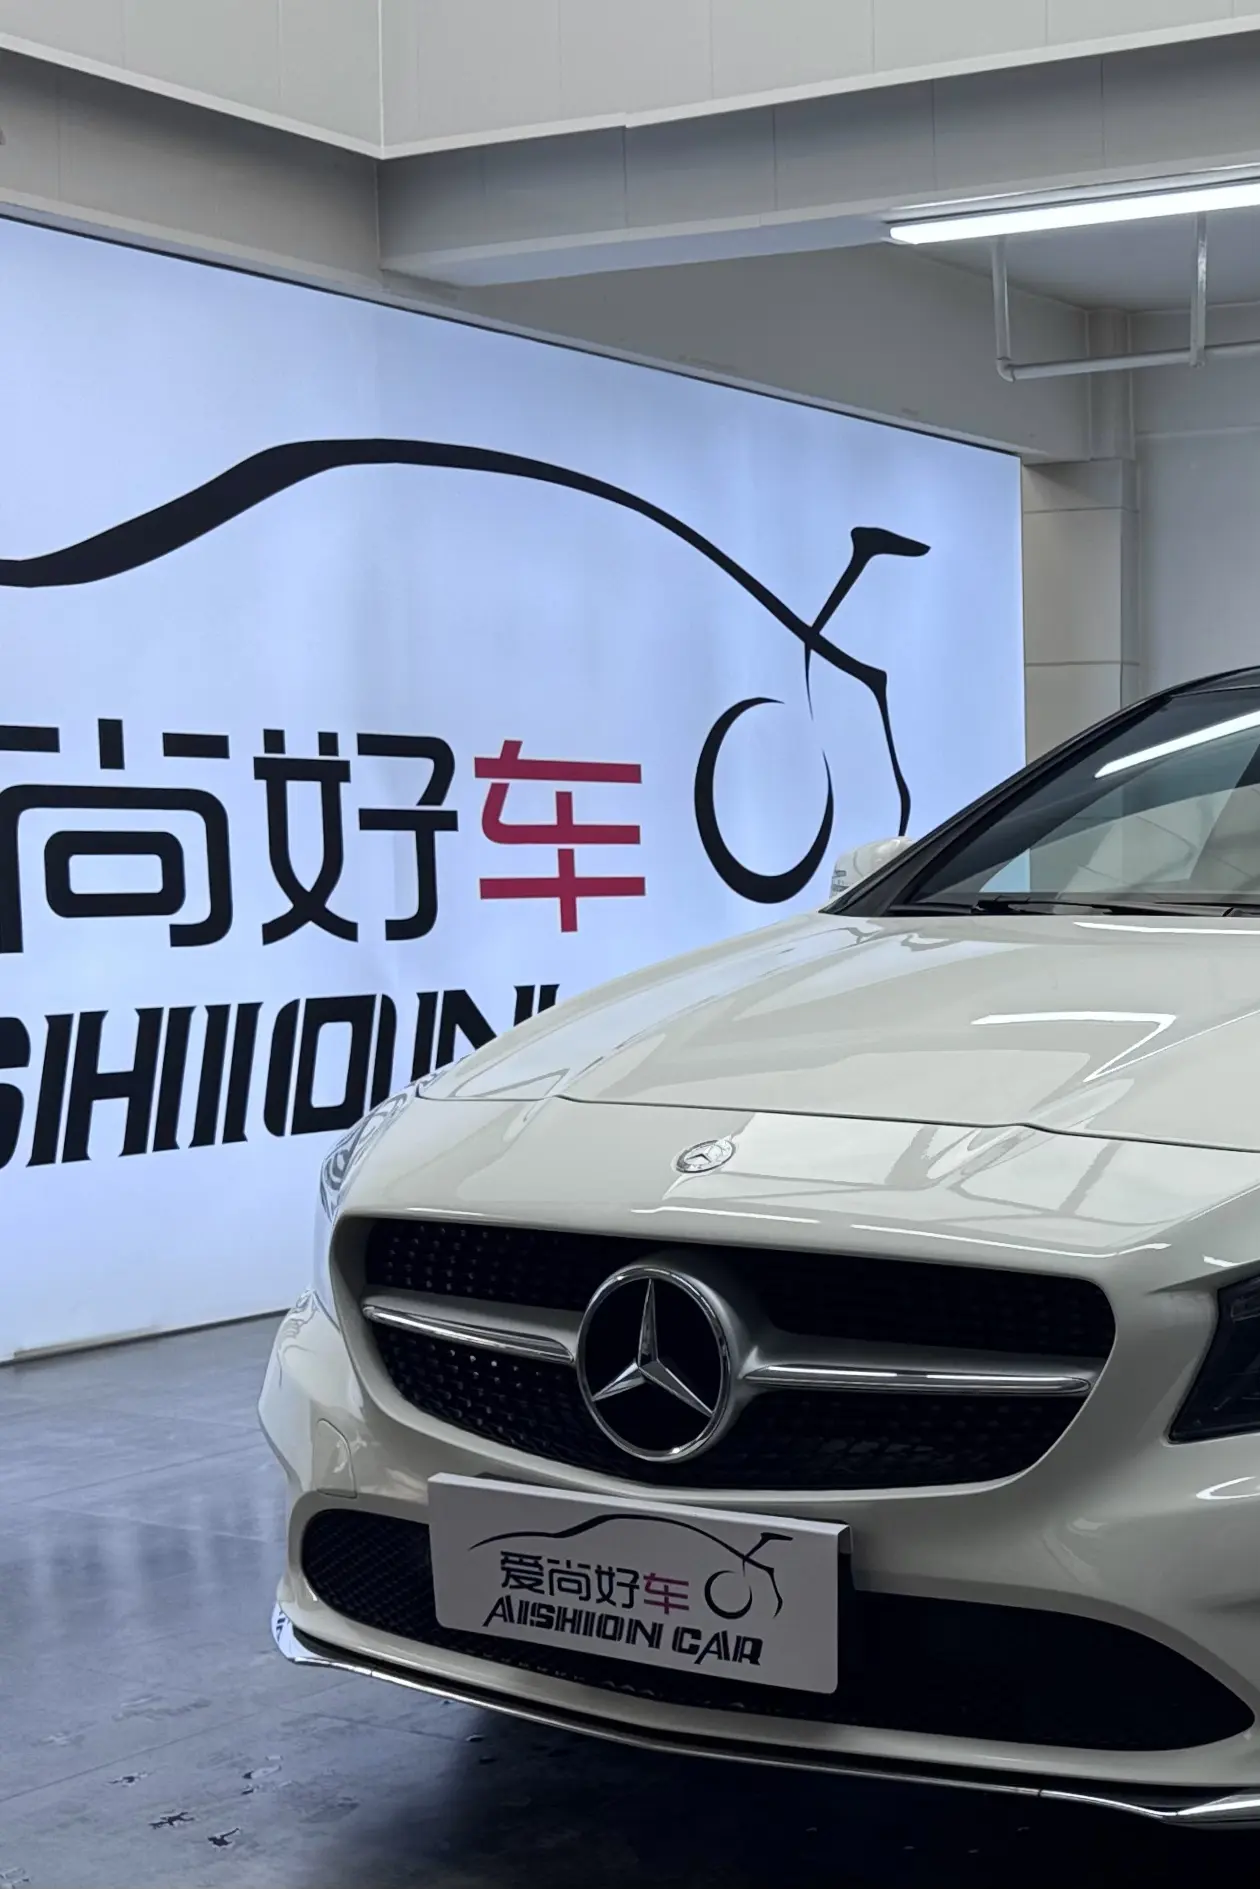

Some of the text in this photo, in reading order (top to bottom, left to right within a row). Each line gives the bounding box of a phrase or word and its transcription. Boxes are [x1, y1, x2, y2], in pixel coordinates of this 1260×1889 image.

[500, 1549, 690, 1615] 爱尚好车
[482, 1595, 764, 1667] AISHION CAR
